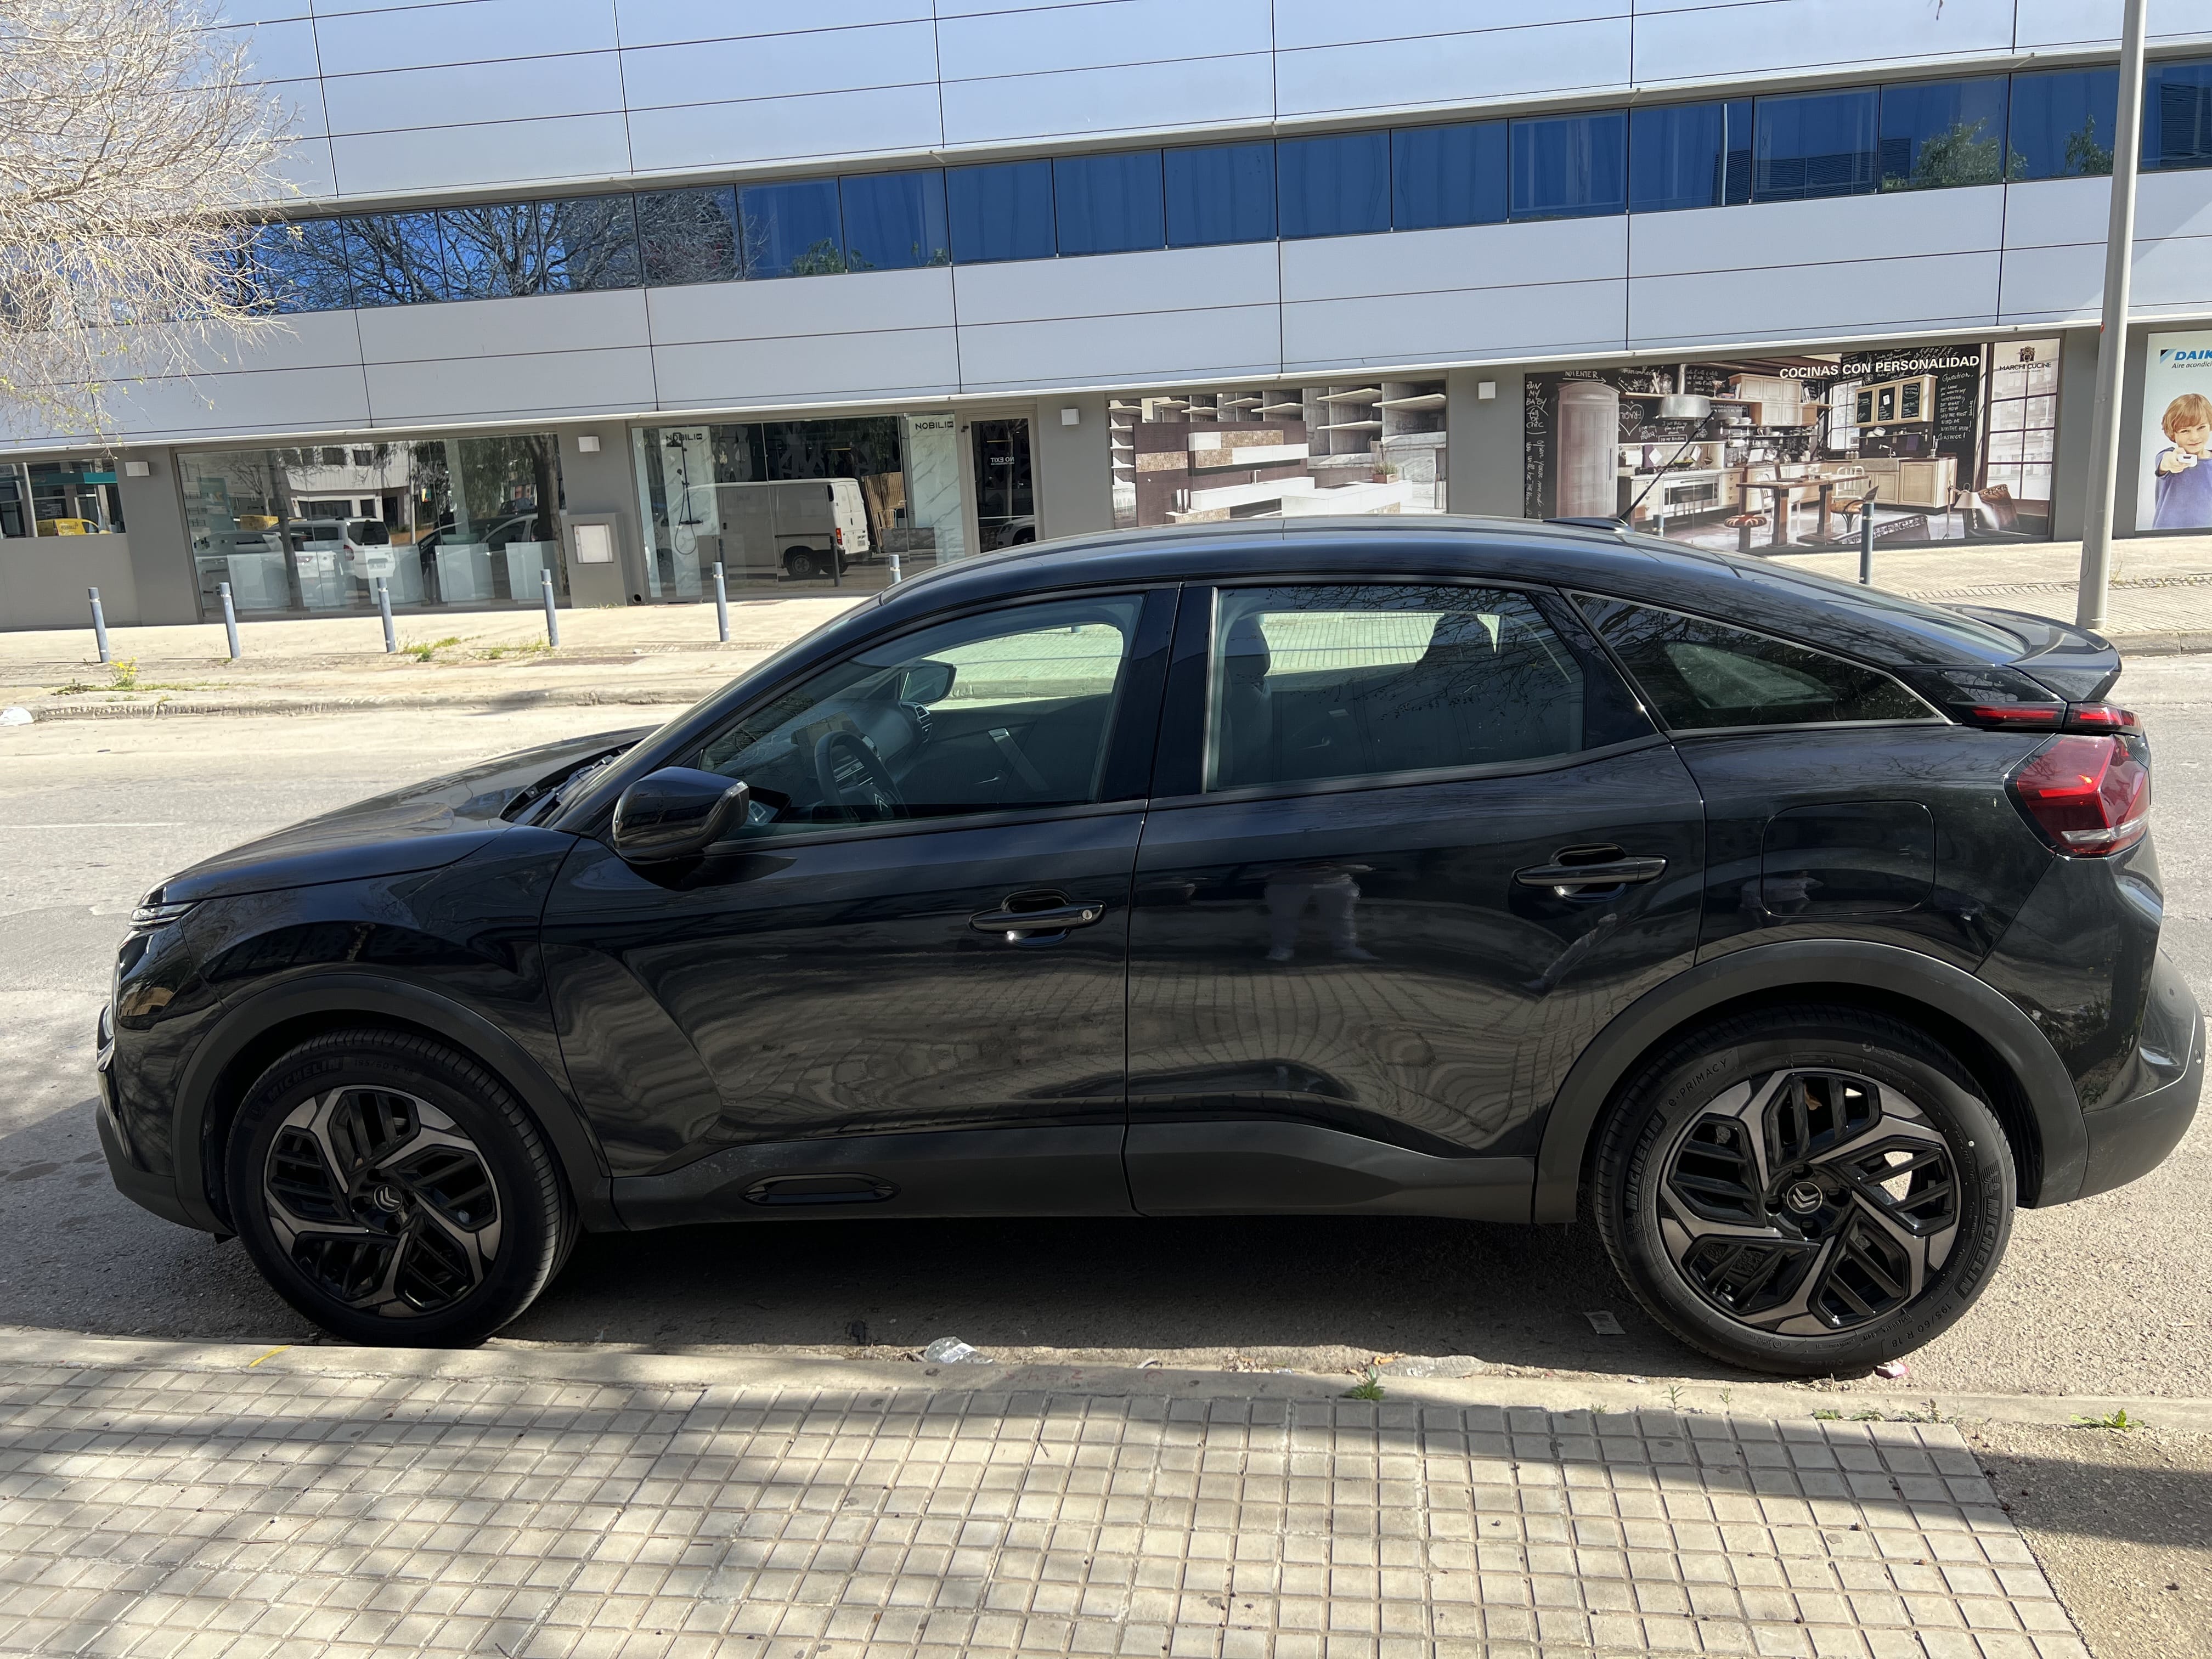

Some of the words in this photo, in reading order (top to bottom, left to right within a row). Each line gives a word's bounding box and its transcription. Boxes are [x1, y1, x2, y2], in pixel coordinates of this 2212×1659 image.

[1780, 365, 1838, 379] COCINAS
[1842, 363, 1871, 375] CON
[1875, 356, 1979, 373] PERSONALIDAD
[267, 1057, 340, 1099] MICHELIN
[1626, 1114, 1663, 1211] MICHELIN
[1959, 1198, 2000, 1295] MICHELIN
[1917, 1302, 1951, 1333] 195/60
[1892, 1337, 1903, 1347] 18
[1906, 1330, 1914, 1340] R
